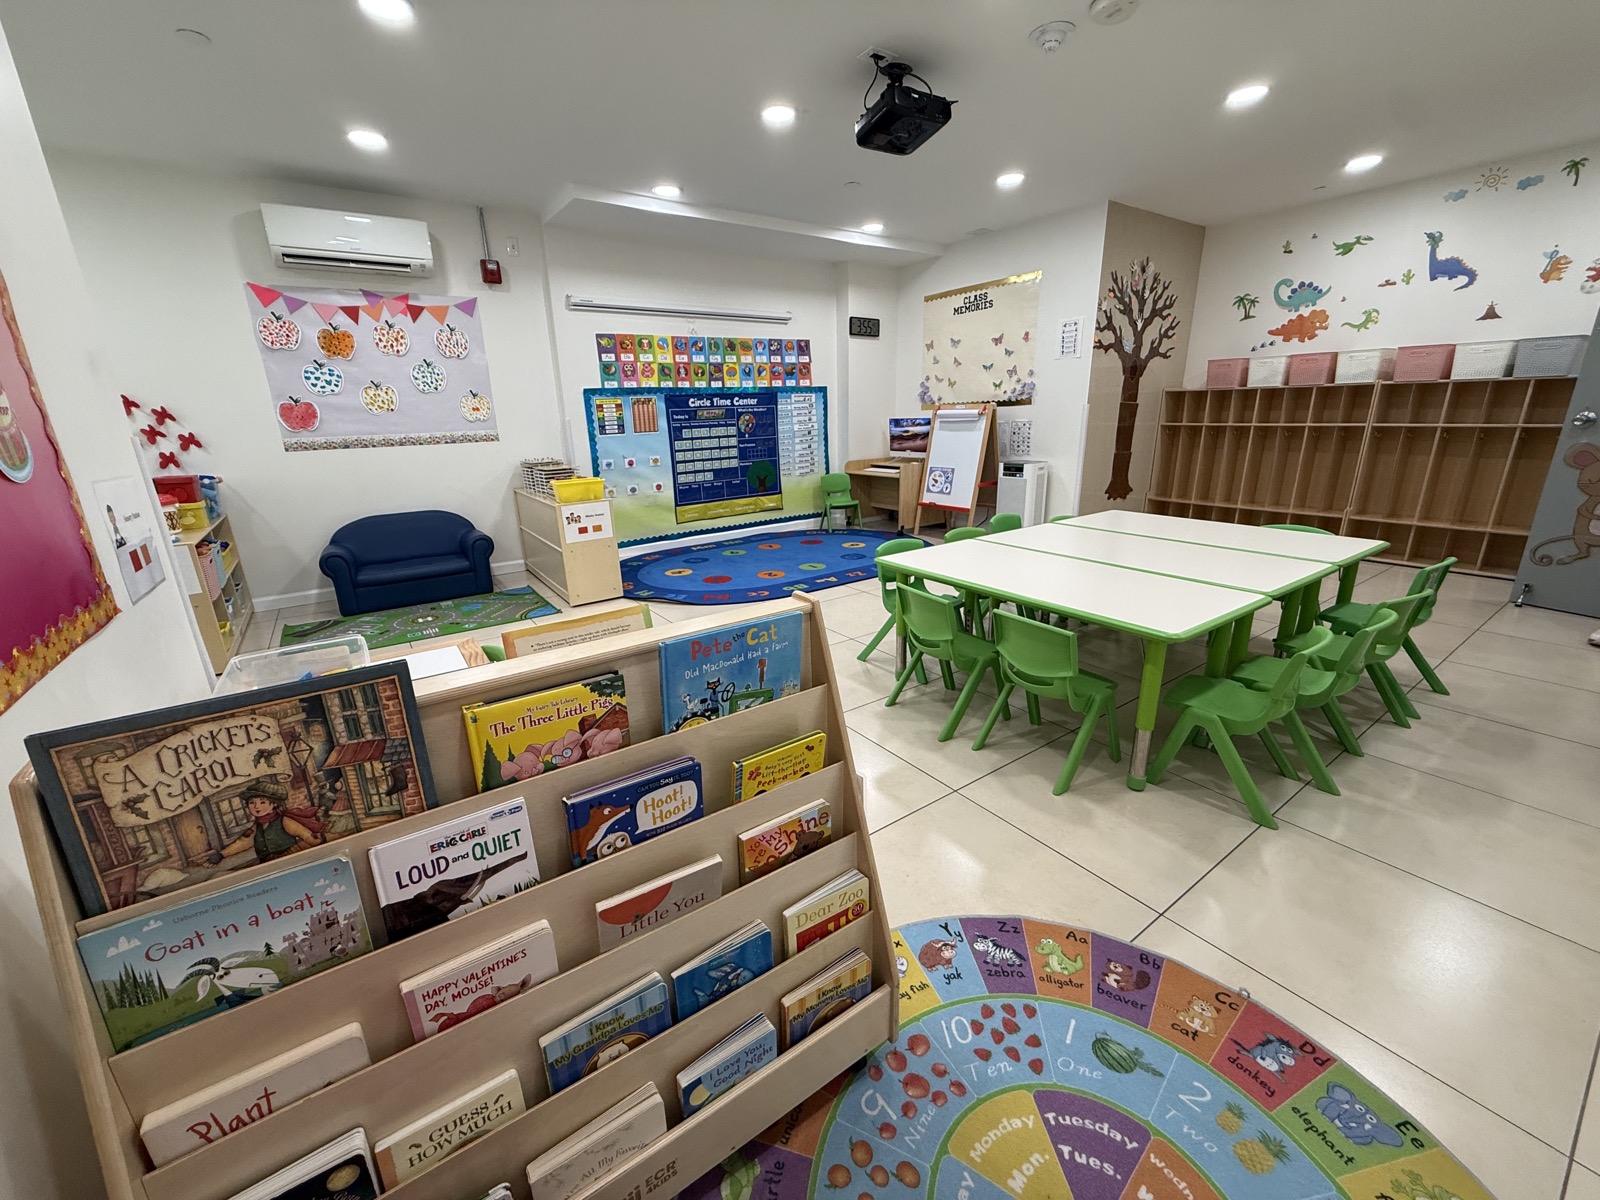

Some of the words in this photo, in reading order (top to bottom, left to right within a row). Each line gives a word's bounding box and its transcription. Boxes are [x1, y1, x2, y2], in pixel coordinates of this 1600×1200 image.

[953, 300, 994, 315] MEMORIES
[963, 292, 988, 305] CLASS
[689, 398, 711, 407] Circle
[713, 398, 731, 406] Time
[733, 397, 758, 405] Center
[690, 638, 732, 661] Pete
[732, 630, 746, 642] the
[746, 624, 778, 646] Cat
[685, 668, 699, 679] Old
[702, 652, 745, 674] MacDonald
[748, 648, 761, 659] Had
[561, 697, 578, 705] Library
[489, 722, 516, 738] The
[518, 714, 554, 730] Three
[556, 705, 588, 721] Little
[590, 698, 613, 711] Pigs
[102, 764, 148, 792] A
[153, 756, 251, 812] CAROL
[660, 776, 673, 785] Say
[757, 764, 810, 788] Peek-a-boo
[643, 785, 683, 814] Hoot!
[652, 796, 692, 825] Hoot!
[429, 836, 458, 853] ERIC
[459, 826, 486, 843] CARLE
[747, 834, 766, 853] You
[765, 827, 782, 846] My
[395, 856, 450, 890] LOUD
[451, 852, 469, 863] and
[471, 828, 521, 861] QUIET
[172, 908, 208, 924] Usborne
[211, 897, 244, 912] Phonics
[246, 885, 278, 899] Readers
[620, 909, 669, 939] Little
[673, 892, 705, 911] You
[795, 902, 834, 929] Dear
[838, 888, 863, 907] Zoo
[144, 930, 205, 962] Goat
[213, 922, 239, 939] in
[248, 914, 259, 927] a
[266, 893, 314, 920] boat
[939, 922, 964, 942] Yy
[998, 921, 1021, 933] Zz
[1065, 930, 1088, 945] Aa
[422, 979, 459, 1002] HAPPY
[462, 948, 527, 984] VALENTINE'S
[943, 967, 963, 985] yak
[986, 966, 1026, 978] zebra
[1139, 953, 1161, 970] Bb
[424, 997, 447, 1014] DAY,
[451, 976, 494, 1002] MOUSE!
[822, 983, 842, 997] Know
[910, 981, 930, 994] fish
[1039, 973, 1085, 990] alligator
[793, 1012, 805, 1023] My
[806, 995, 834, 1013] Mommy
[835, 984, 856, 996] Loves
[1096, 983, 1147, 1012] beaver
[1214, 991, 1240, 1012] Cc
[554, 1053, 571, 1068] My
[573, 1026, 617, 1055] Grandpa
[618, 1013, 647, 1029] Loves
[648, 1004, 663, 1015] Me
[588, 1027, 593, 1036] I
[595, 1012, 626, 1033] Know
[942, 1015, 973, 1050] 10
[1065, 1018, 1075, 1044] 1
[1170, 1021, 1200, 1042] cat
[713, 1064, 740, 1088] Good
[744, 1046, 773, 1069] Night
[717, 1057, 741, 1076] Love
[1057, 1056, 1103, 1080] One
[1298, 1040, 1332, 1067] Dd
[963, 1056, 1013, 1082] Ten
[1227, 1055, 1276, 1099] donkey
[860, 1088, 898, 1122] 9
[1178, 1082, 1212, 1113] 2
[186, 1086, 276, 1144] Plant
[429, 1102, 489, 1142] GUESS
[780, 1104, 803, 1145] unico
[904, 1103, 936, 1149] Nine
[1164, 1103, 1218, 1153] Two
[408, 1134, 454, 1168] HOW
[458, 1101, 513, 1139] MUCH
[969, 1113, 1035, 1162] Monday
[1044, 1112, 1139, 1150] Tuesday
[1291, 1104, 1355, 1166] elephant
[1395, 1120, 1426, 1150] Ee
[645, 1159, 678, 1188] ECR
[1007, 1152, 1049, 1194] Mon.
[1058, 1144, 1122, 1180] Tues.
[646, 1169, 678, 1195] 4KIDS
[763, 1160, 784, 1200] rtle
